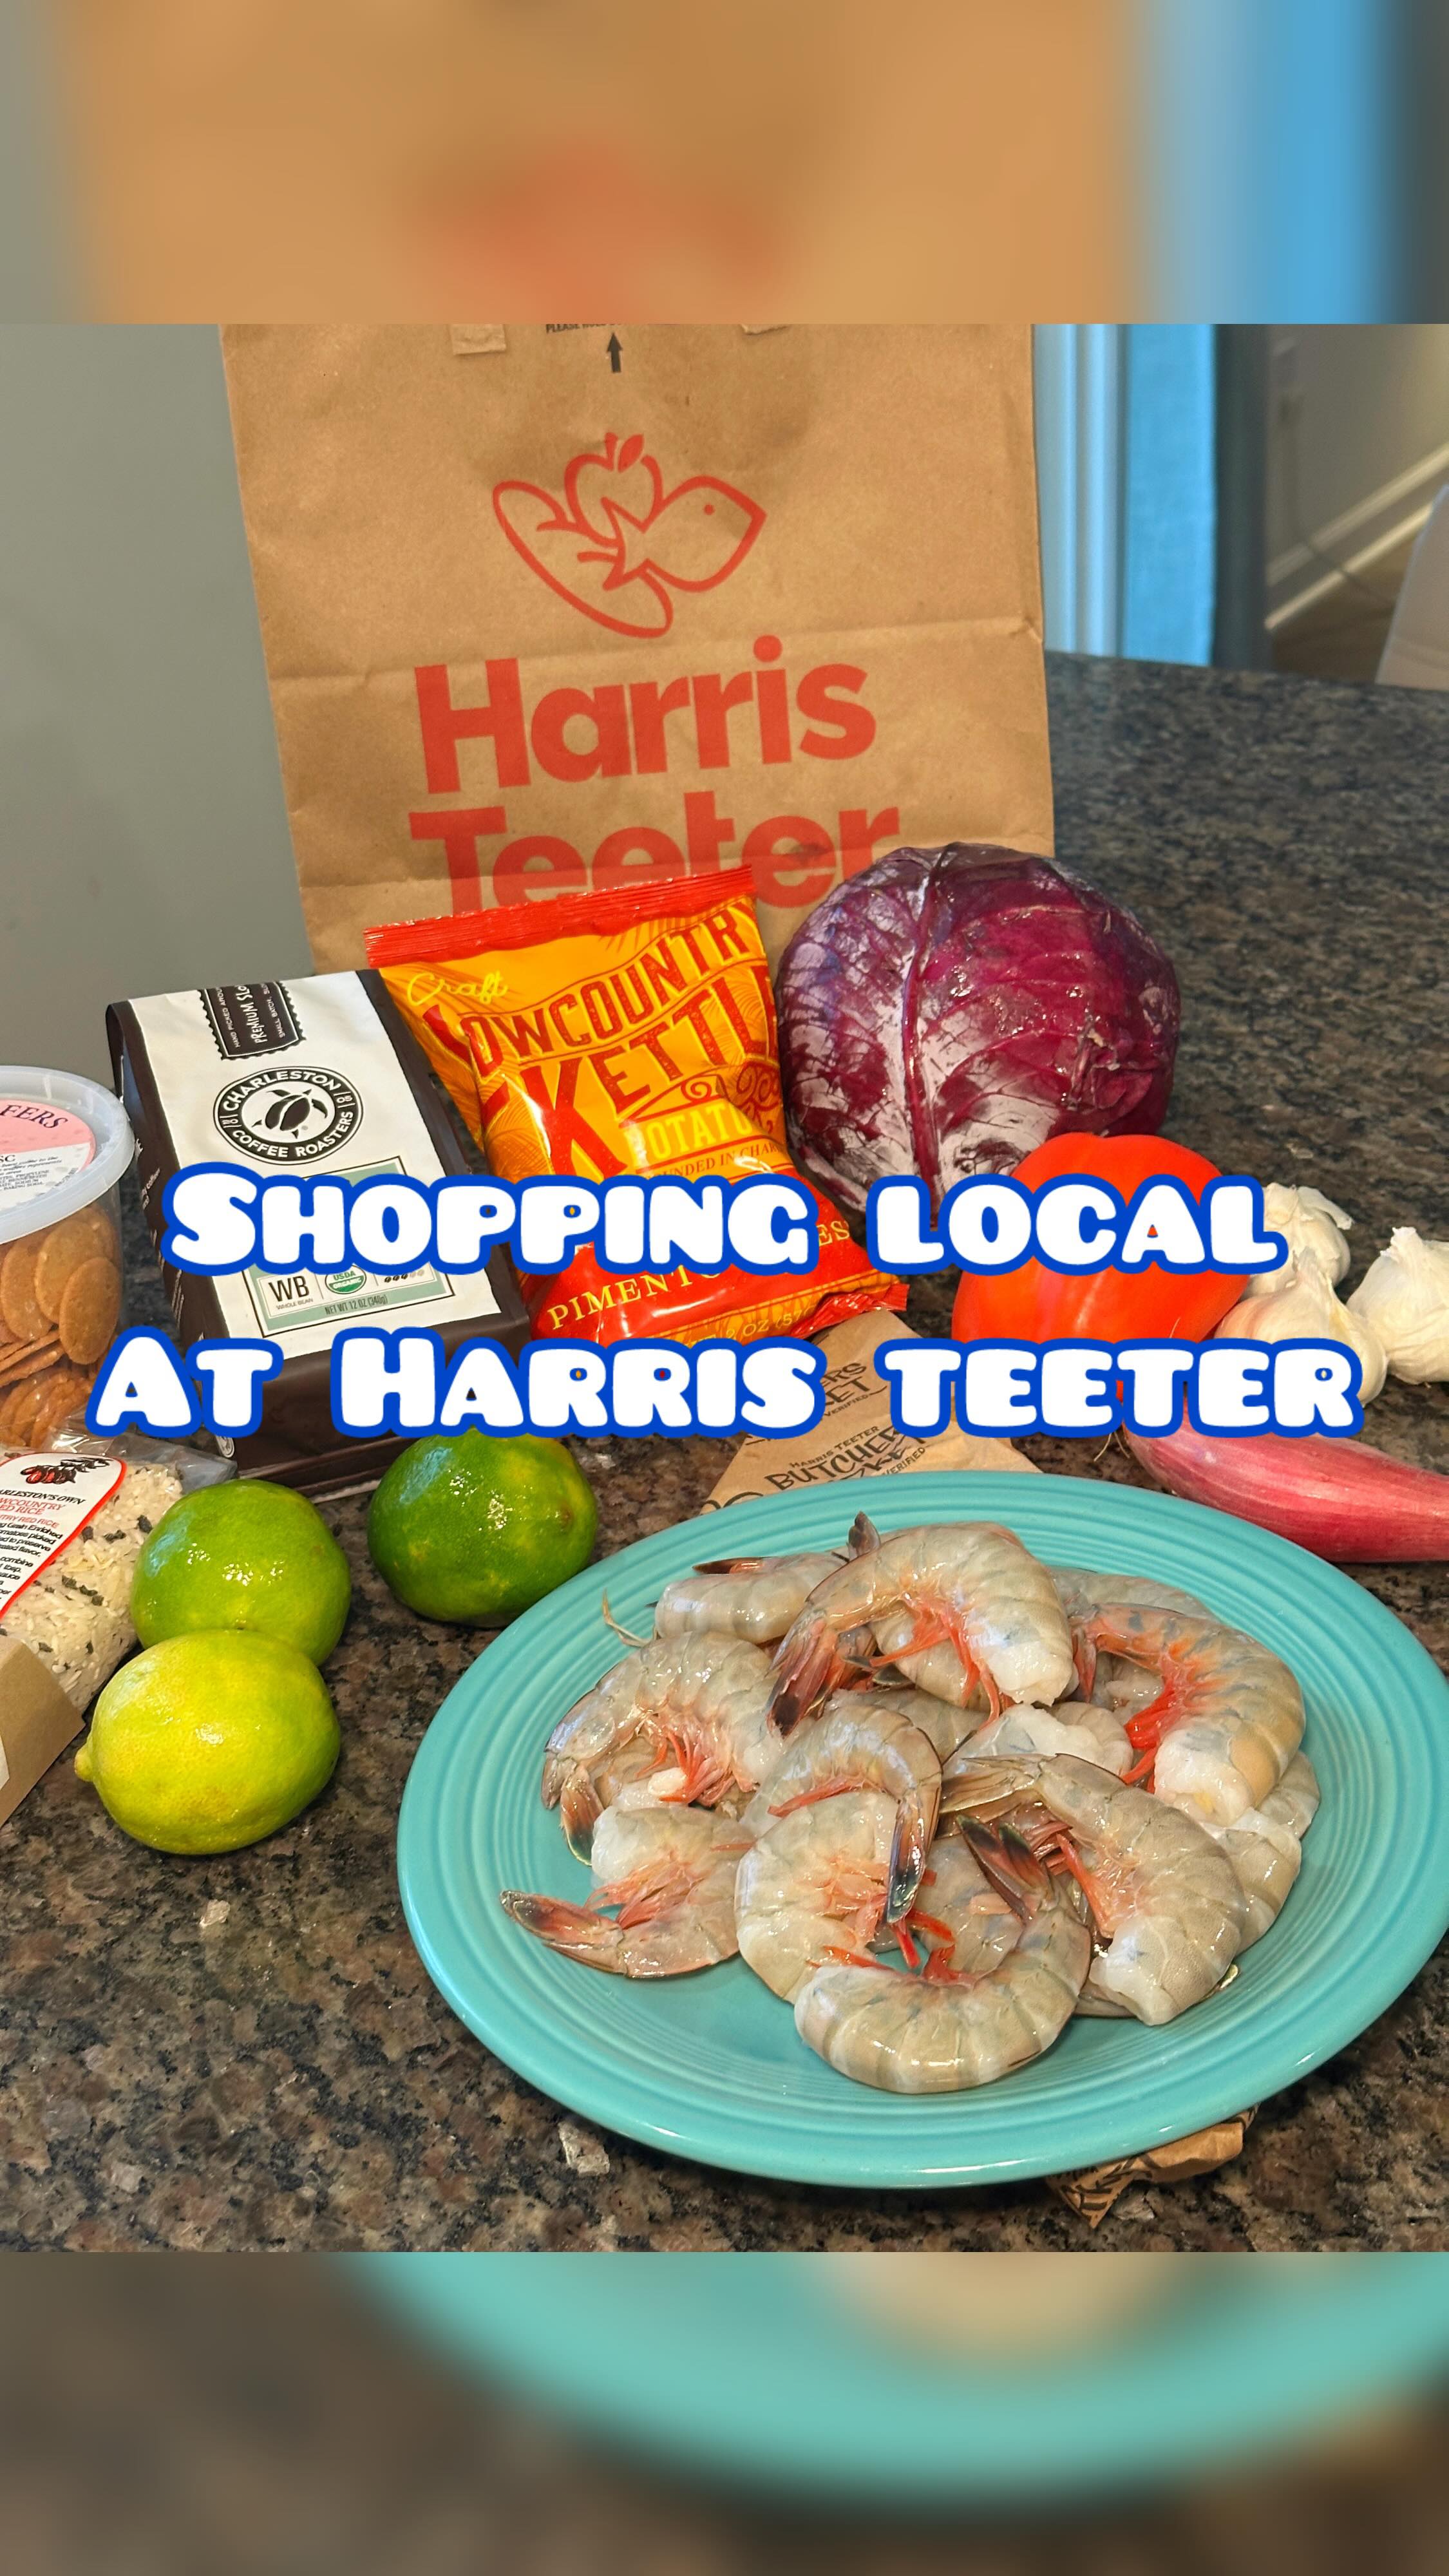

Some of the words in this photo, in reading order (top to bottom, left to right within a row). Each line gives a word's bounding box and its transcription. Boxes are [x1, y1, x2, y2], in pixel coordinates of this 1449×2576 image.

[415, 635, 876, 794] Harris
[409, 791, 900, 913] Teeter
[216, 987, 225, 1006] AROU
[234, 985, 253, 1001] SLO
[406, 970, 508, 1006] Craft
[240, 1002, 268, 1044] PREMIUM
[223, 1070, 341, 1112] CHARLESTON
[232, 1130, 289, 1158] COFFEE
[295, 1111, 354, 1157] ROASTERS
[333, 1271, 355, 1280] USDA
[269, 1275, 310, 1302] WB
[547, 1264, 721, 1329] PIMENT
[276, 1300, 297, 1310] WHOLE
[297, 1298, 314, 1306] BEAN
[325, 1305, 337, 1315] NET
[337, 1302, 348, 1312] WT
[350, 1300, 357, 1309] 12
[358, 1298, 367, 1307] OZ
[743, 1320, 769, 1336] OZ
[824, 1393, 869, 1417] VERIFIED
[789, 1449, 834, 1469] HARRIS
[835, 1425, 880, 1449] TEETER
[57, 1496, 86, 1504] OWN
[28, 1524, 63, 1539] Enriched
[37, 1519, 59, 1528] RICE
[16, 1539, 52, 1551] preserve
[28, 1533, 57, 1544] picked
[18, 1546, 41, 1557] flavor.
[1, 1557, 33, 1567] combine
